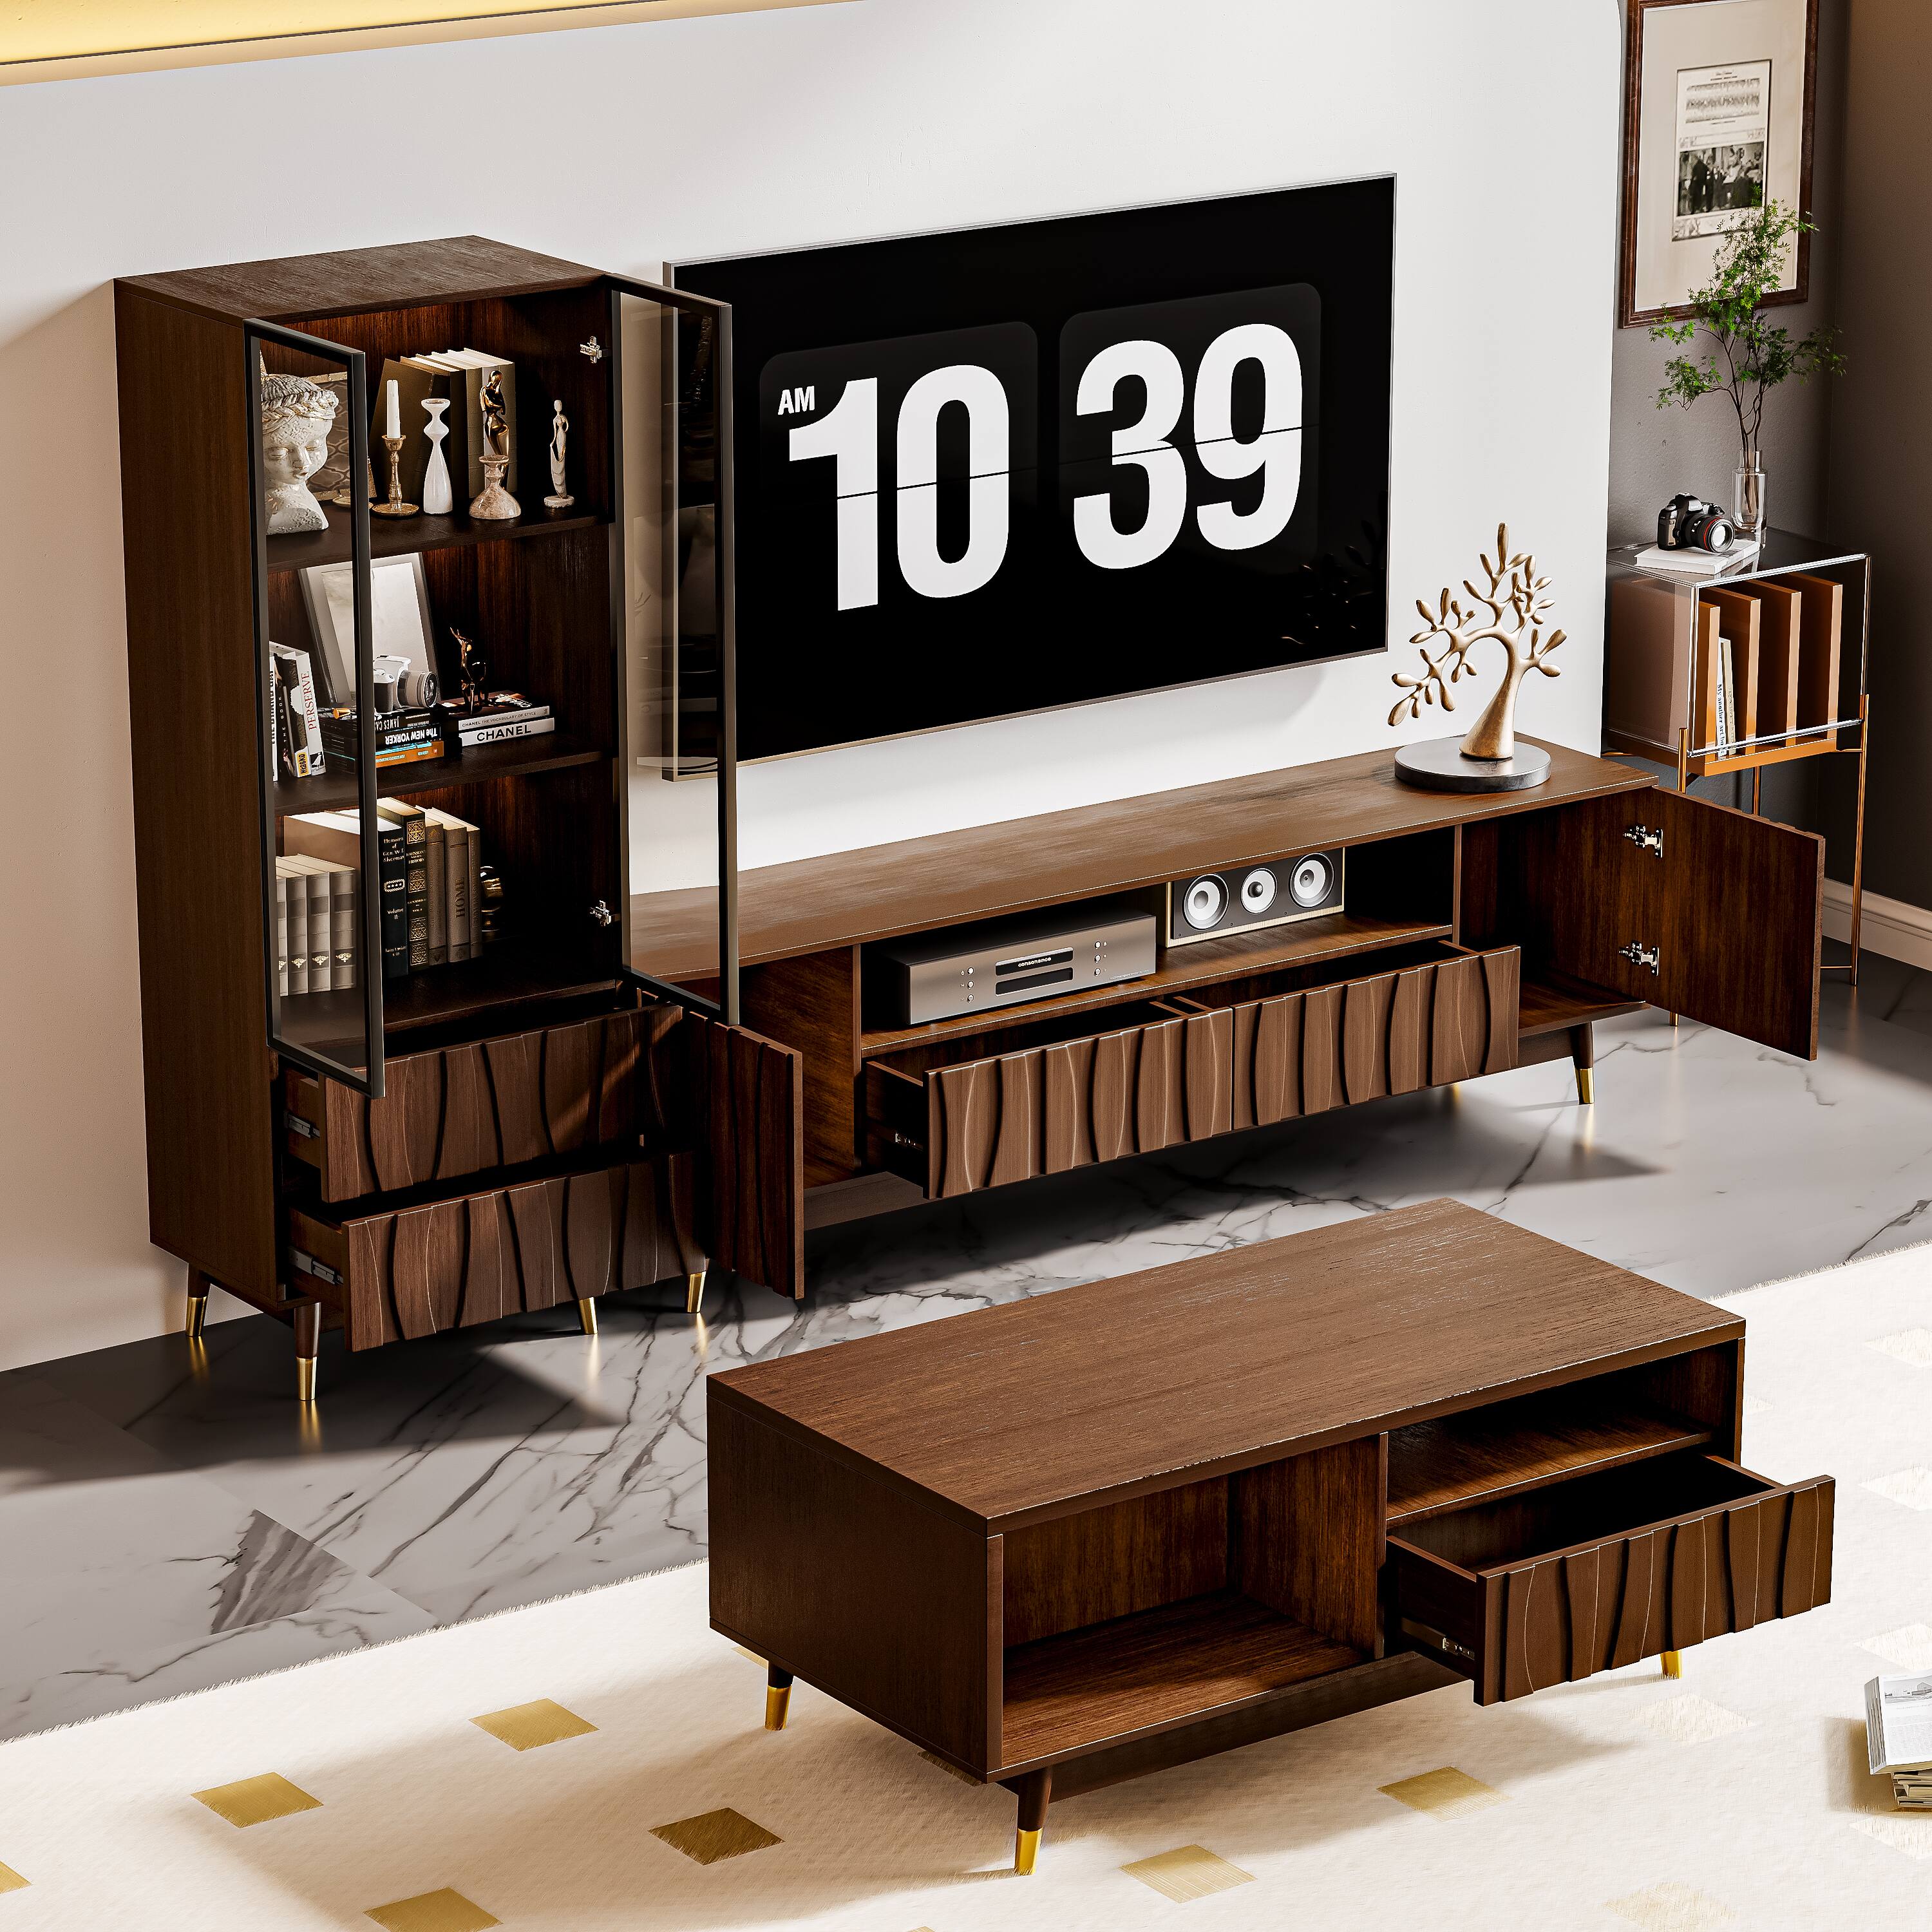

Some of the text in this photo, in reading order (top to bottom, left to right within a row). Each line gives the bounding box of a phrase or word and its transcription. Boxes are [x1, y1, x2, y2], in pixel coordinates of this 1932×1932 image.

[778, 386, 815, 415] AM
[789, 323, 1302, 611] 10 39
[301, 671, 317, 731] PERSERVE
[384, 716, 400, 730] JAMES
[490, 714, 517, 723] VOCABULARY
[384, 728, 438, 745] The NEW YORKER
[477, 724, 532, 742] CHANEL
[454, 877, 466, 919] HOME
[1018, 956, 1052, 967] consonance
